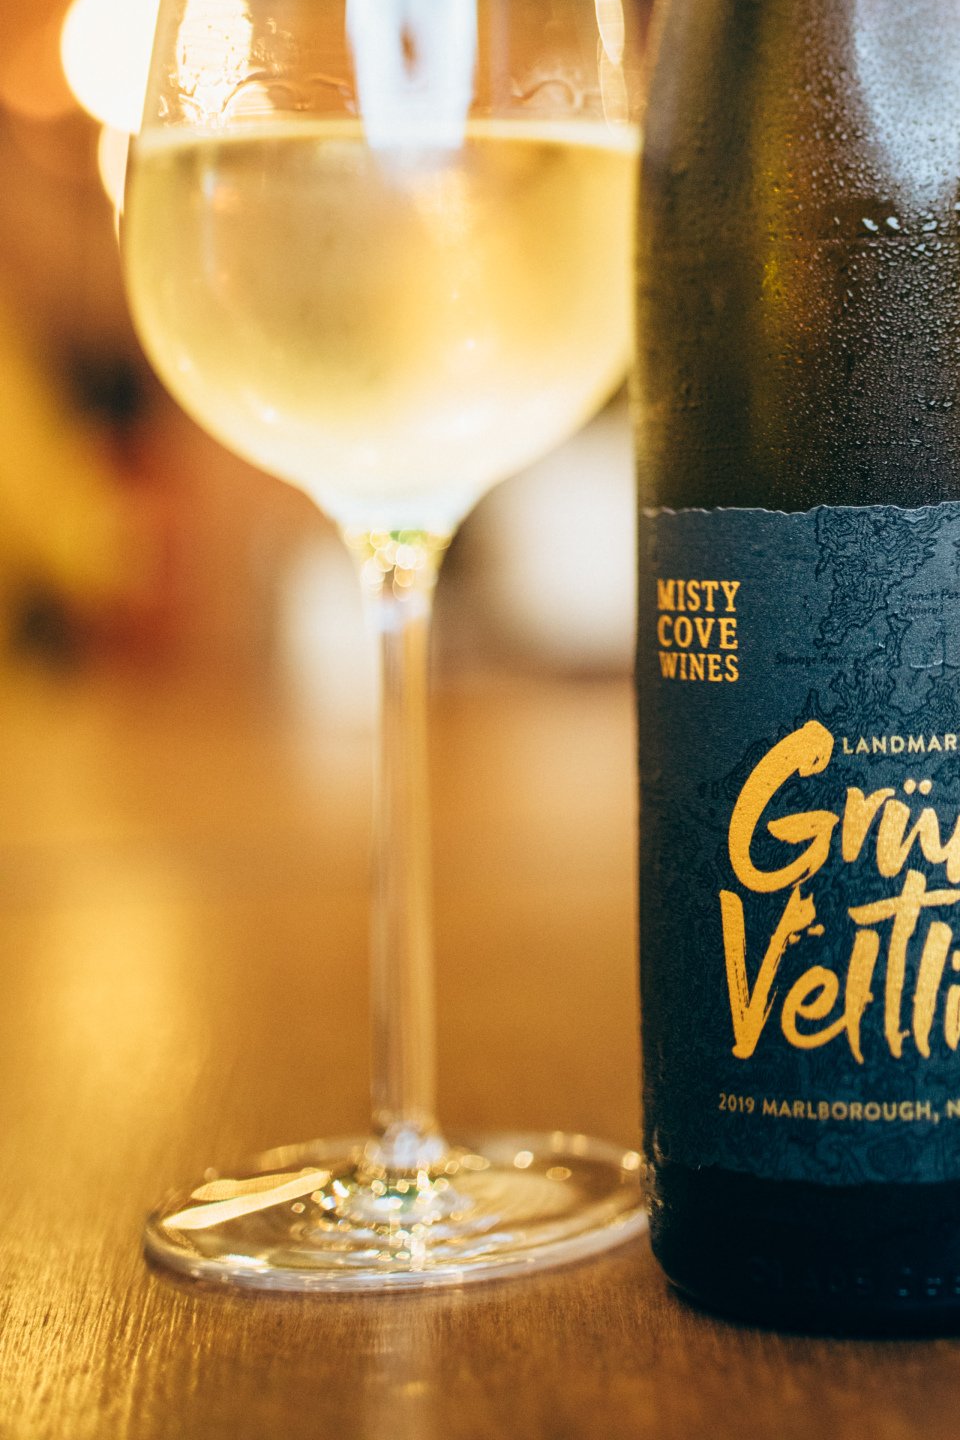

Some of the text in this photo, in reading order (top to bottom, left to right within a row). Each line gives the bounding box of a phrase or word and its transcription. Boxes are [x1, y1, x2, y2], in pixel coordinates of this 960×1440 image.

[657, 578, 740, 612] MISTY
[657, 615, 739, 650] COVE
[658, 651, 739, 682] WINES
[718, 1092, 755, 1114] 2019
[762, 1098, 940, 1124] MARLBOROUGH,
